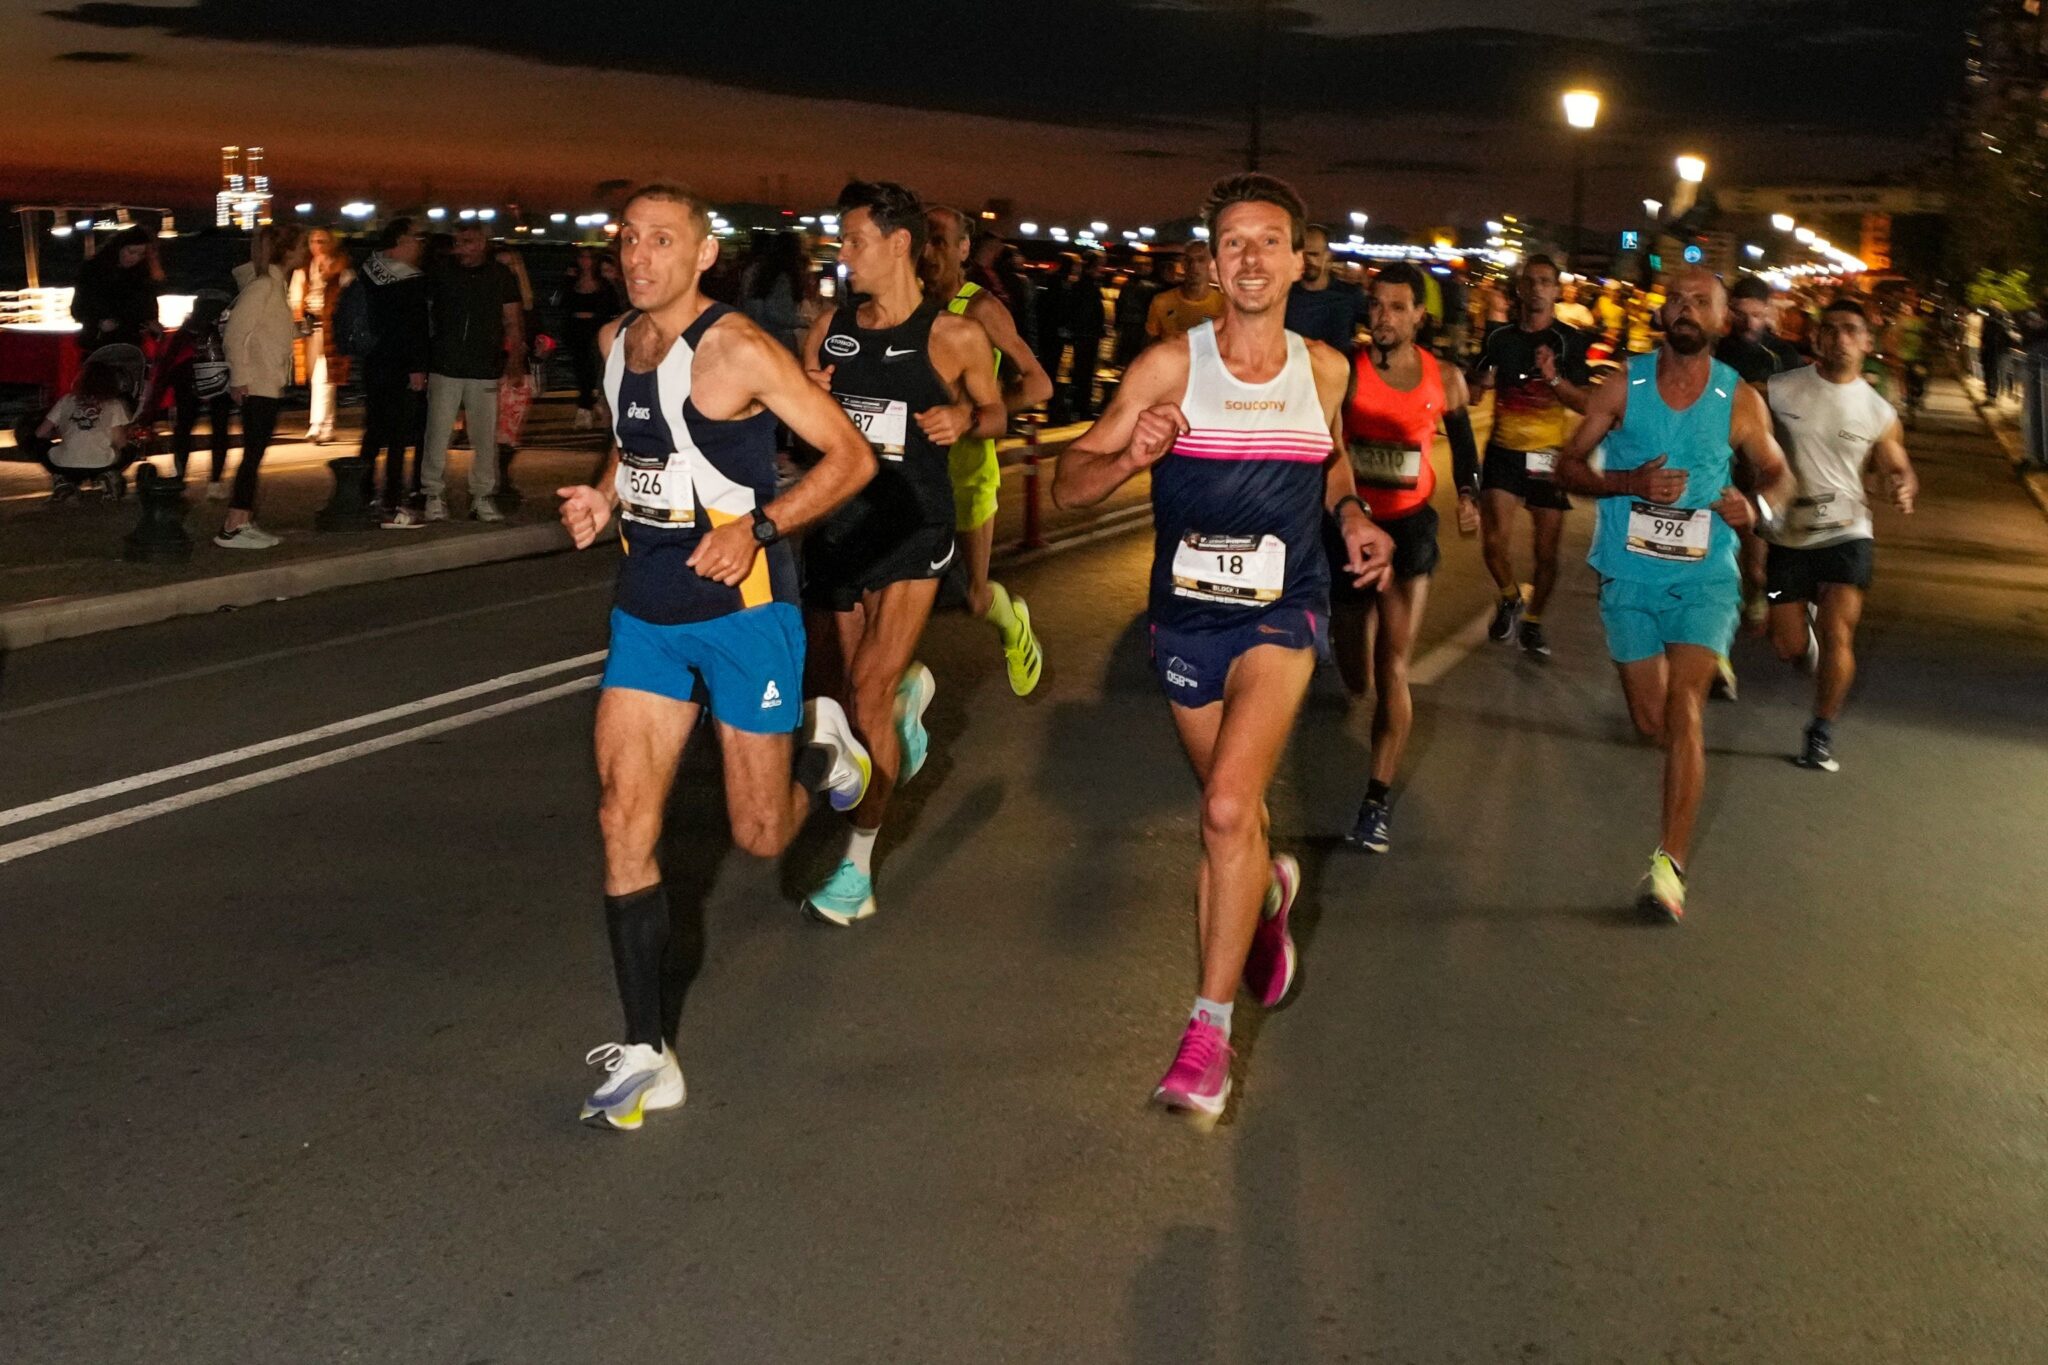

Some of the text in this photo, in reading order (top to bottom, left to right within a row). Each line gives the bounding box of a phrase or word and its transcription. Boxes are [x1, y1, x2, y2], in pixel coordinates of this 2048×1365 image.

[1224, 400, 1286, 413] saucony
[630, 470, 662, 496] 526
[1654, 520, 1684, 537] 996
[1216, 555, 1243, 574] 18
